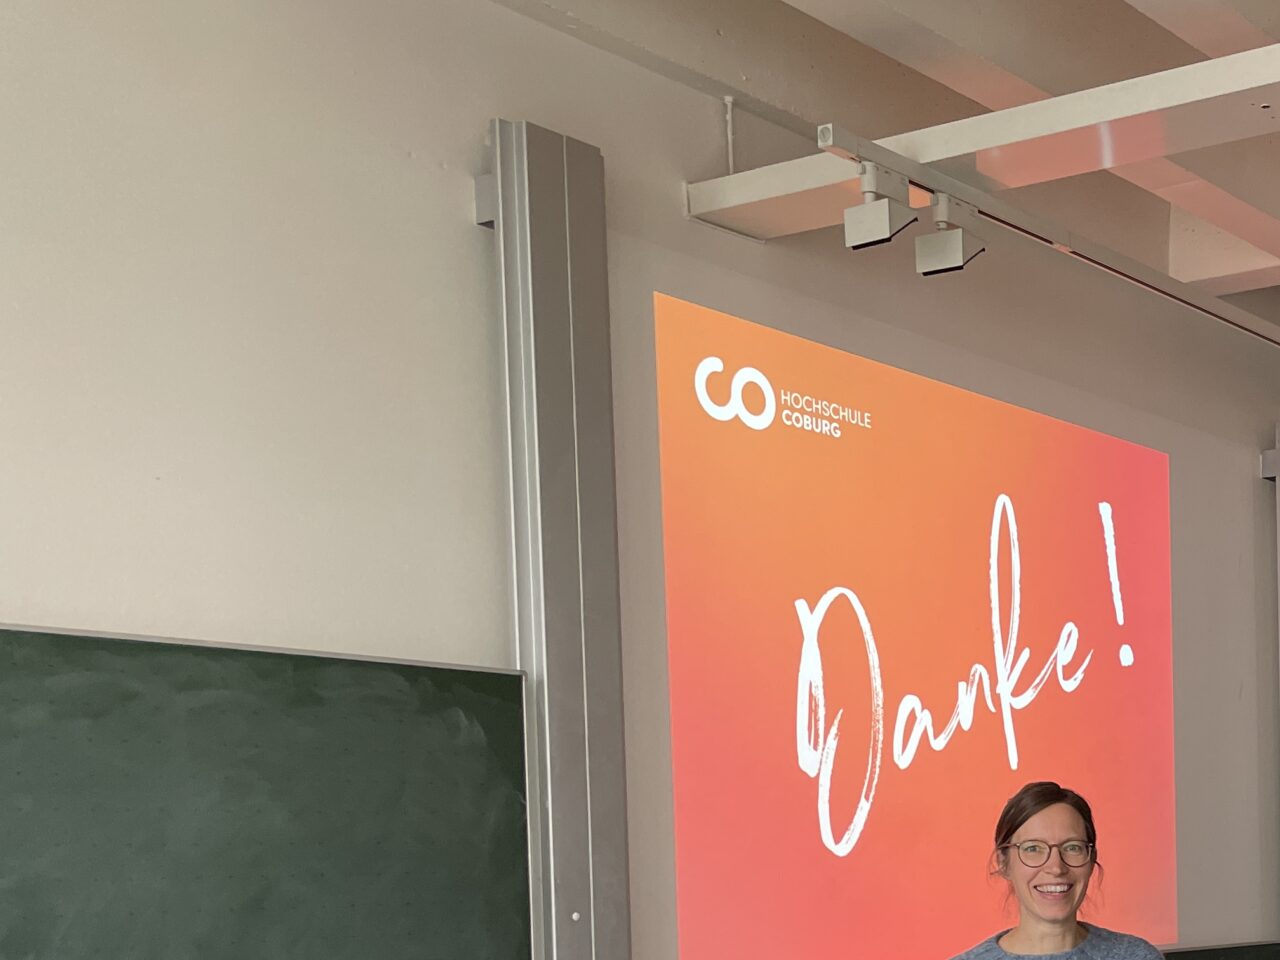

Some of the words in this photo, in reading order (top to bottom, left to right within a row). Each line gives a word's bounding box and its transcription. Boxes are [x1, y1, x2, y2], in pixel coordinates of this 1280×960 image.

[695, 356, 776, 430] CO
[781, 389, 872, 428] HOCHSCHULE
[782, 410, 842, 438] COBURG
